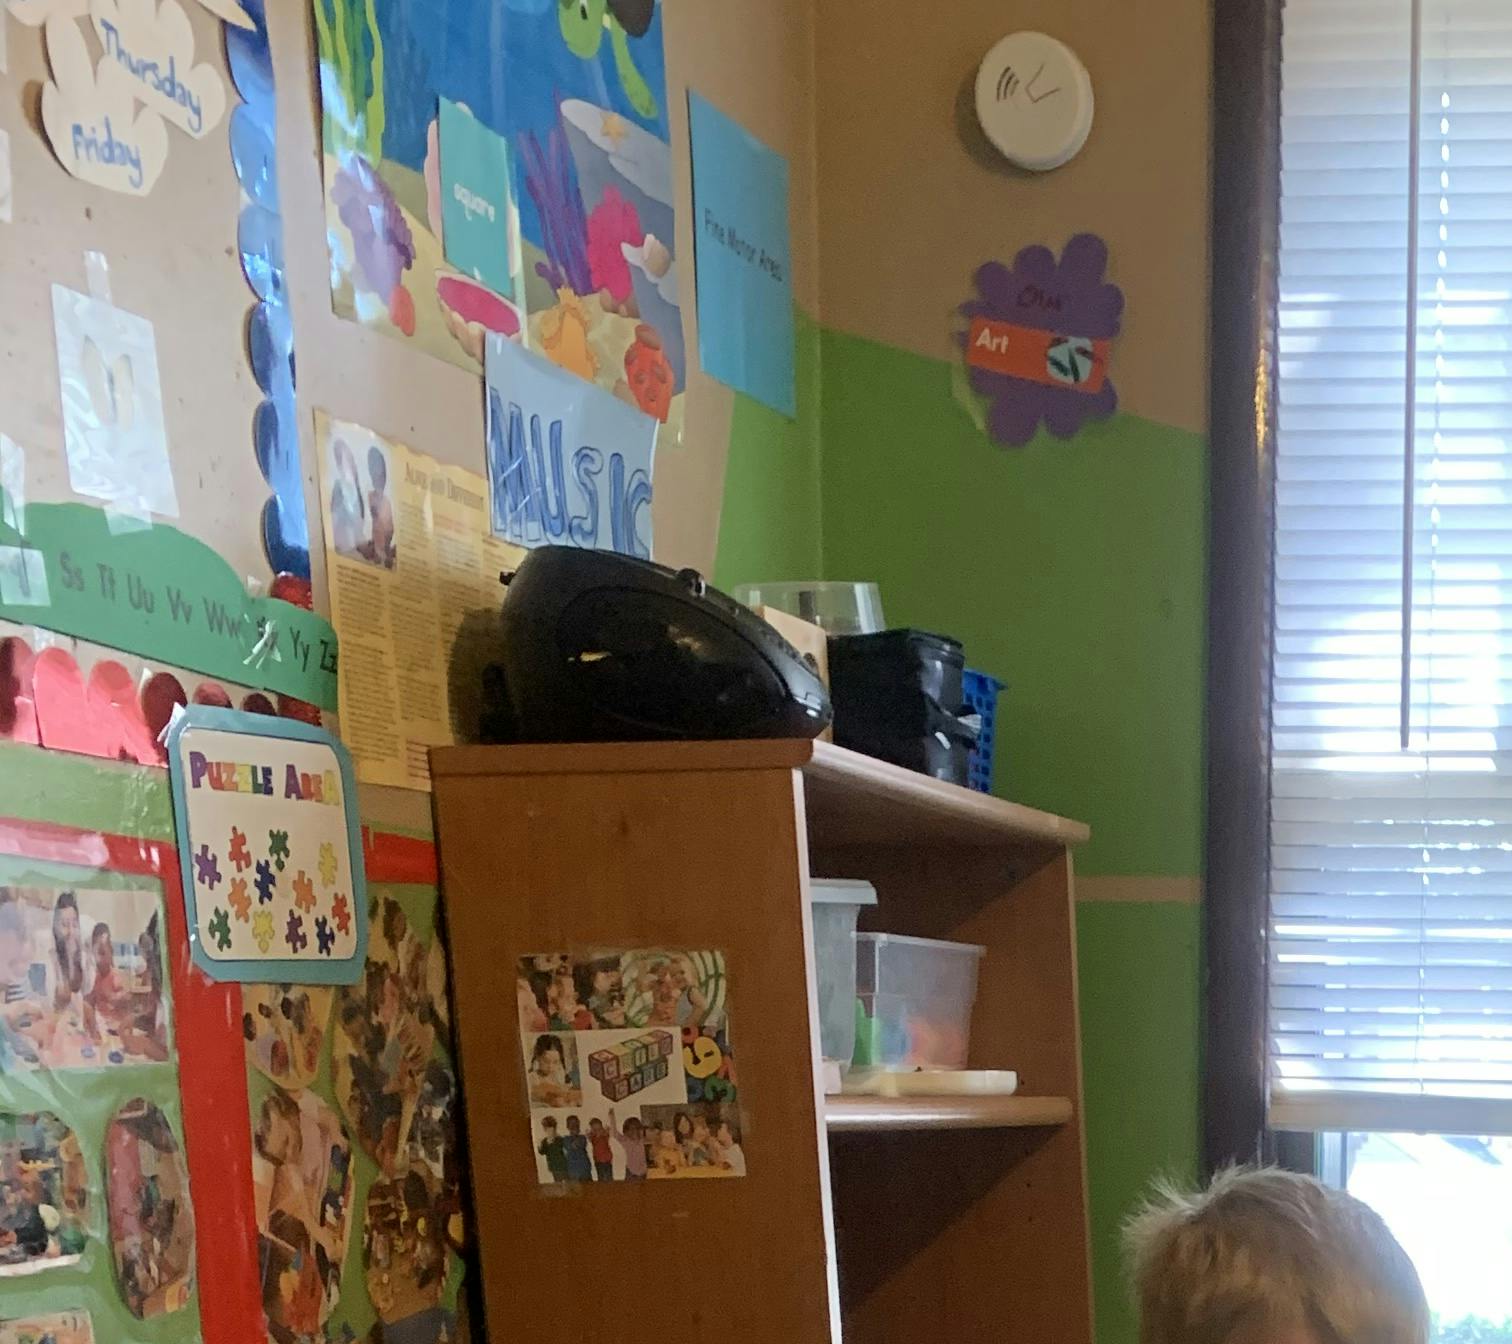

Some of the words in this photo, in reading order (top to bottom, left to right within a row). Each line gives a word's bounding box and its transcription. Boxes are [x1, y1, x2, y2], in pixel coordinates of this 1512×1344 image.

[100, 18, 202, 133] Thursday
[72, 115, 143, 188] Friday
[976, 327, 1009, 354] Art
[488, 386, 653, 561] MUSIC
[289, 626, 310, 672] Yy
[189, 751, 273, 795] PUZZLE
[284, 764, 340, 806] AREA
